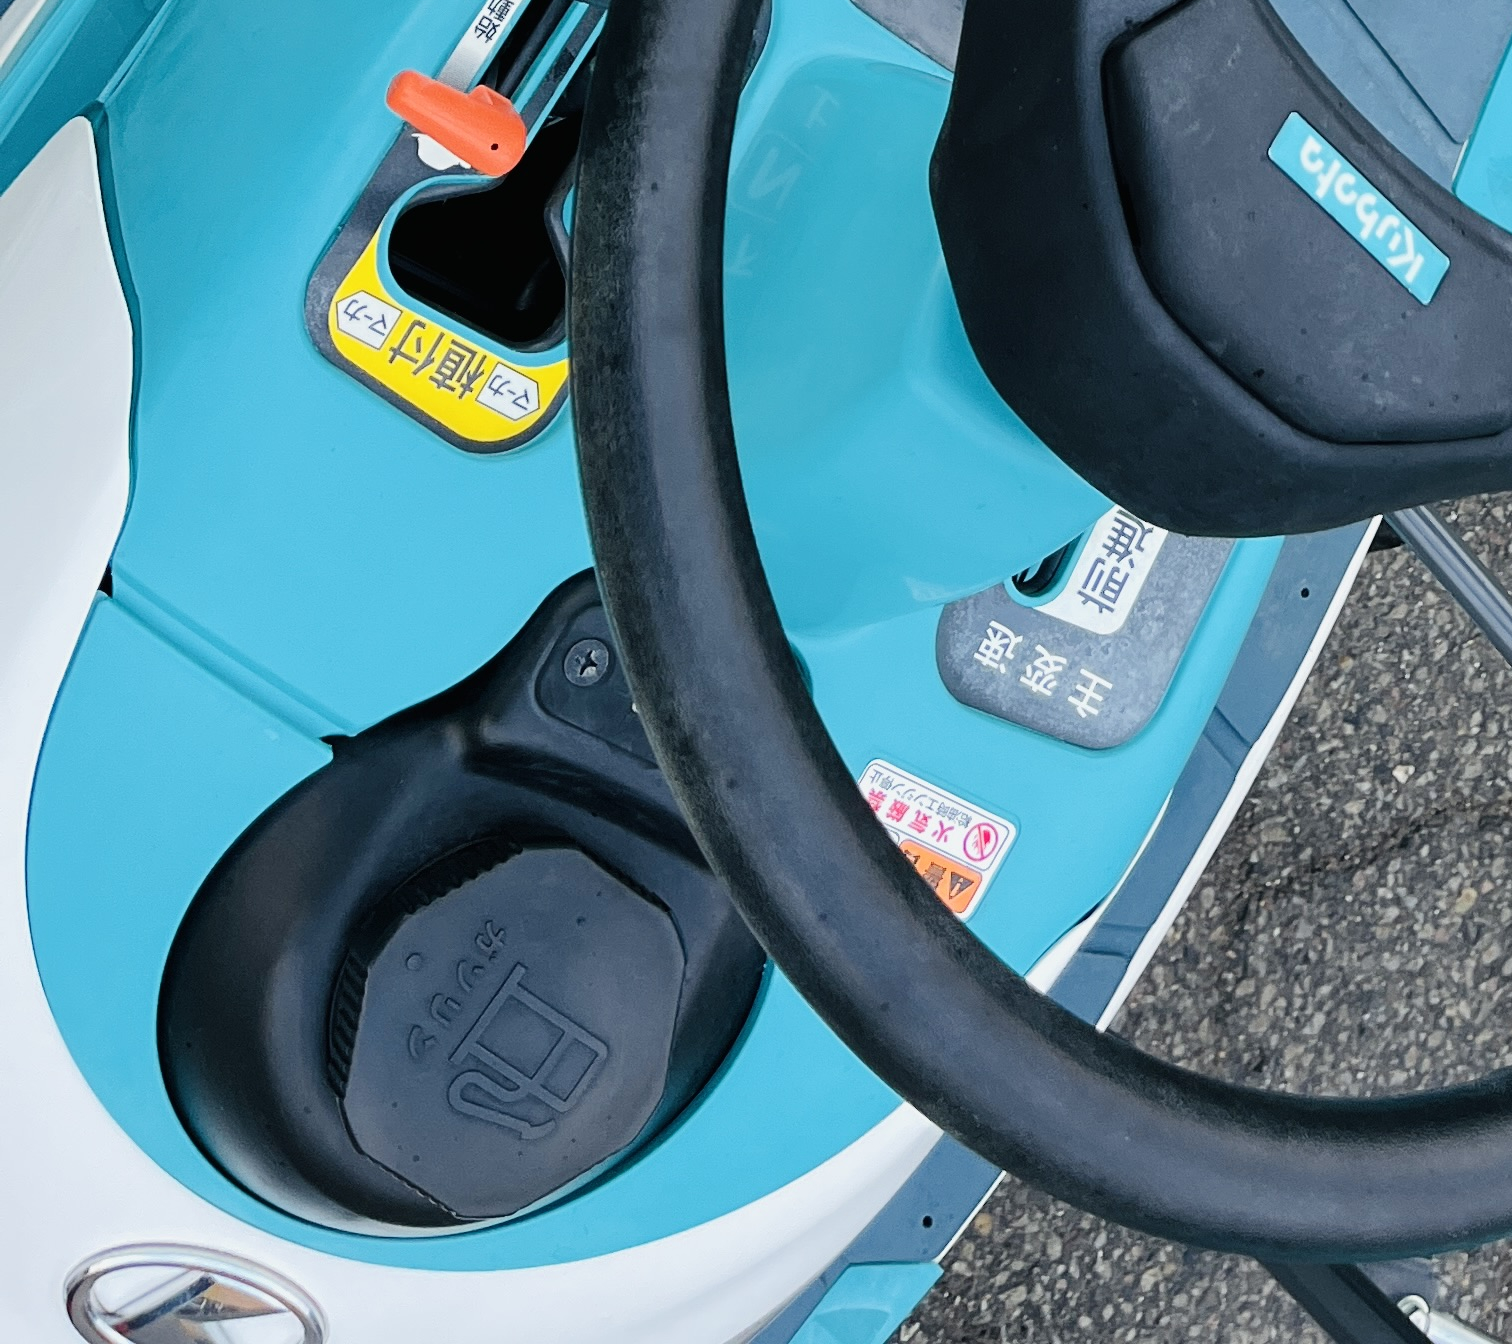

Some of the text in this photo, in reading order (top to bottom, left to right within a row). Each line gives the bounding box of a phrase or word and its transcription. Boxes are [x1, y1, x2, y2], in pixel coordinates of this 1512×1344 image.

[1300, 135, 1425, 284] Kubota
[343, 298, 531, 412] マーカ 植付 マーカ
[1077, 508, 1155, 614] 前進
[973, 620, 1114, 718] 主変速
[867, 788, 955, 843] 火気厳禁
[406, 919, 506, 1059] ガソリン
